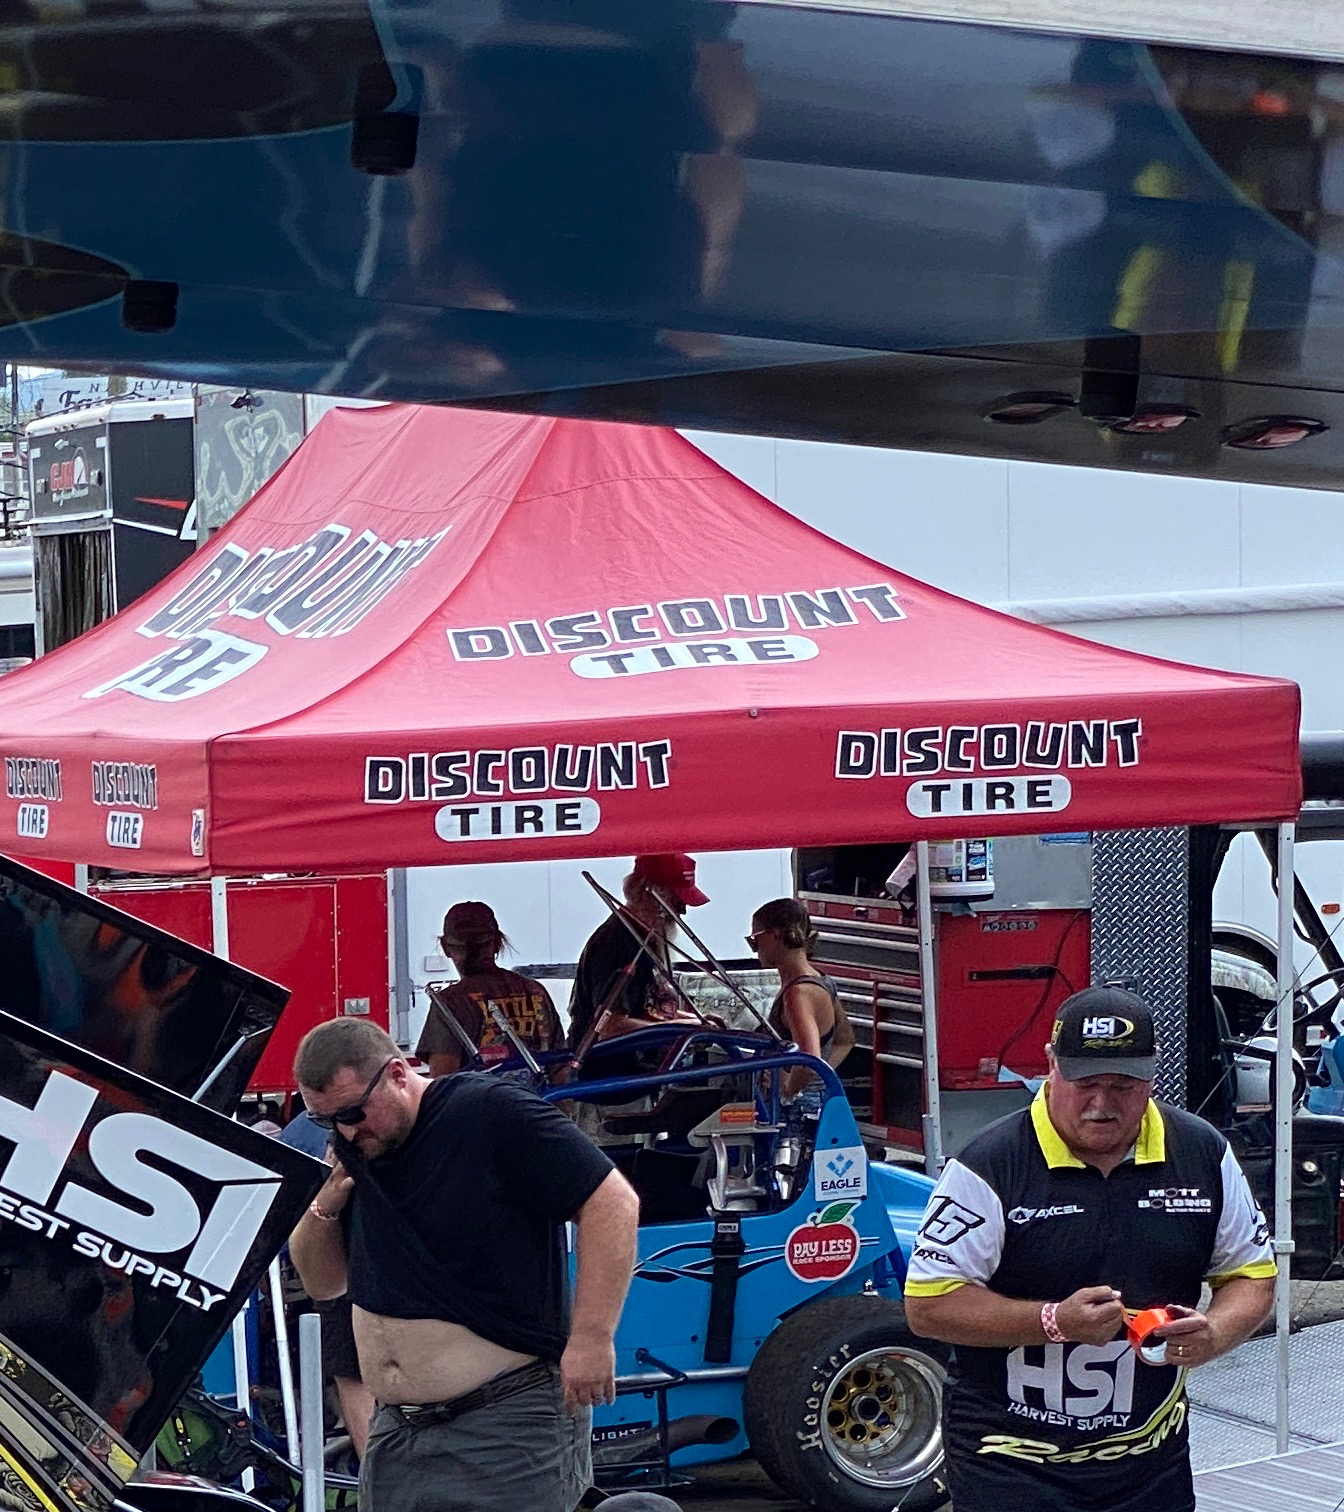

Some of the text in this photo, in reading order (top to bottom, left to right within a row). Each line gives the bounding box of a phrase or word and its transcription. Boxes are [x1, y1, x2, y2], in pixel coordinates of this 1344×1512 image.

[447, 584, 909, 663] DISCOUNT
[590, 636, 796, 675] TIRE
[835, 719, 1143, 780] DISCOUNT
[4, 757, 62, 802] DISCOUNT
[92, 761, 158, 810] DISCOUNT
[364, 740, 672, 804] DISCOUNT
[918, 780, 1054, 815] TIRE
[20, 806, 46, 835] TIRE
[110, 814, 141, 845] TIRE
[451, 801, 588, 838] TIRE
[1082, 1016, 1115, 1035] HSI
[821, 1177, 861, 1191] EAGLE
[1148, 1187, 1199, 1199] MOTT
[1034, 1204, 1085, 1219] AXCEL
[793, 1238, 852, 1258] PAY LESS
[72, 1230, 227, 1312] SUPPLY
[1006, 1340, 1136, 1417] HSI
[1007, 1402, 1131, 1431] HARVEST SUPPLY
